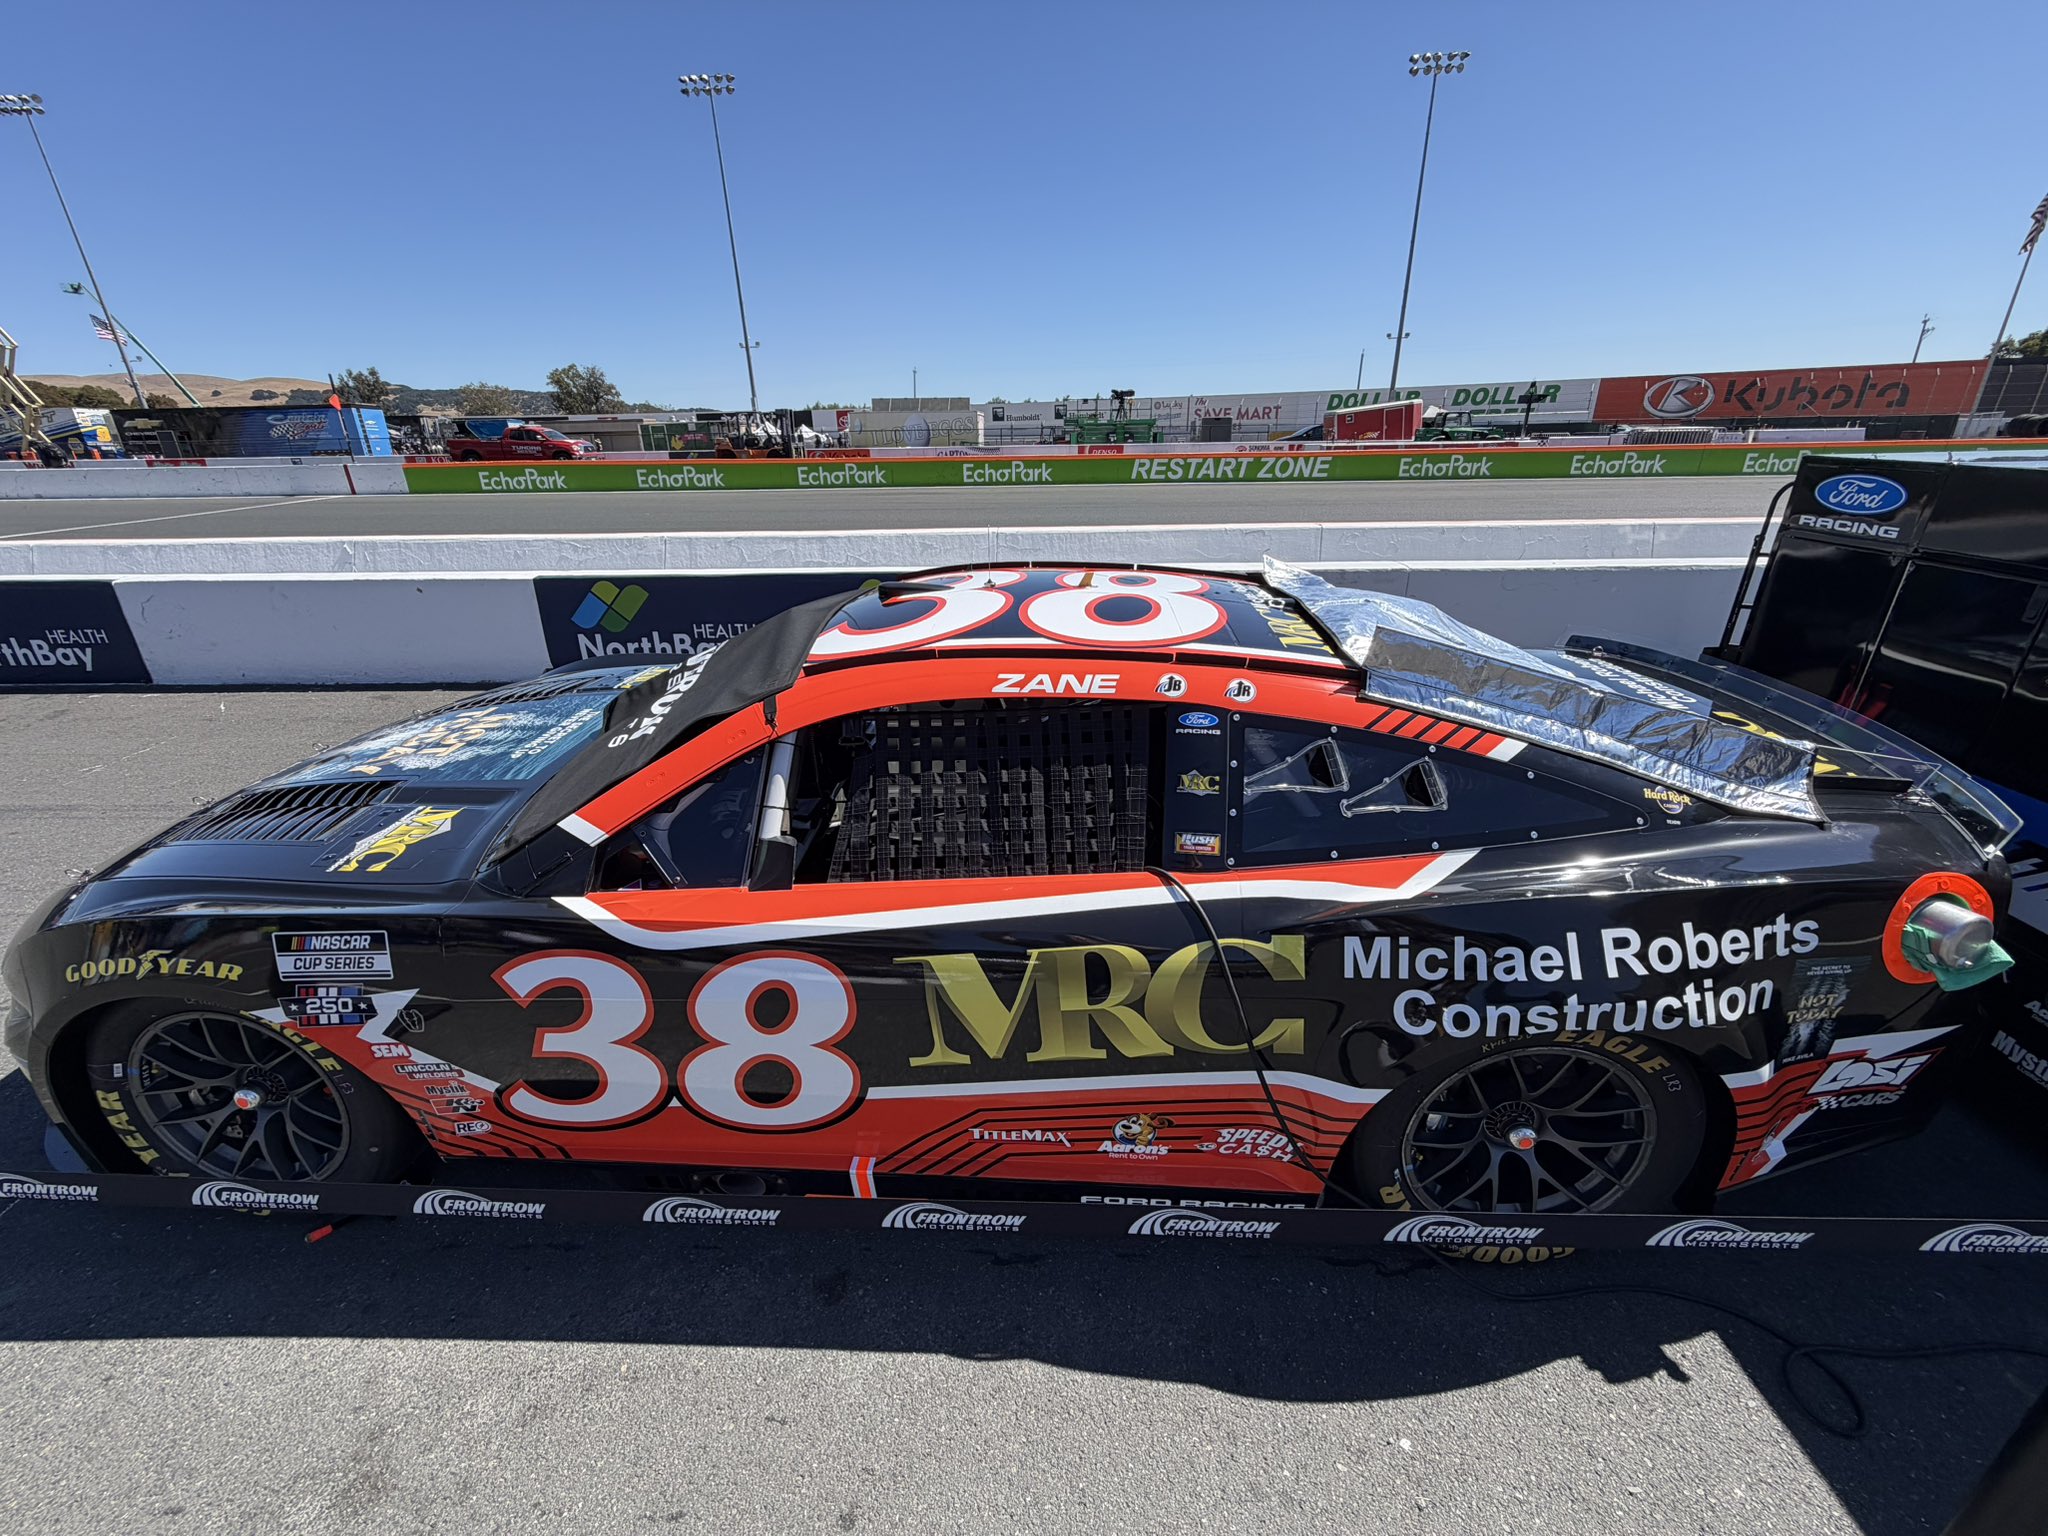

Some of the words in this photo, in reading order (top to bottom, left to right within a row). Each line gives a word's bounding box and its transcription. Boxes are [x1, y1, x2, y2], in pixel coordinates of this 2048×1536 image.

[1723, 373, 1910, 411] Kubota
[1006, 413, 1041, 421] Humboldt
[1194, 407, 1232, 419] SAVE
[1236, 406, 1282, 420] MART
[882, 424, 925, 445] LOVE
[927, 416, 975, 439] EGGS
[1131, 457, 1254, 480] RESTART
[1257, 456, 1333, 479] ZONE
[1398, 454, 1493, 477] EchoPark
[1570, 451, 1667, 475] EchoPark
[1742, 449, 1812, 473] EchoP
[636, 465, 725, 488] EchoPark
[797, 463, 887, 485] EchoPark
[963, 460, 1053, 482] EchoPark
[478, 468, 568, 490] EchoPark
[1829, 479, 1888, 509] Ford
[1798, 515, 1900, 539] RACING
[804, 568, 1228, 661] 38
[45, 629, 109, 644] HEALTH
[577, 631, 726, 660] NorthBa
[992, 673, 1120, 694] ZANE
[1185, 714, 1211, 725] Ford
[1176, 773, 1221, 791] MRC
[1643, 788, 1667, 801] Hard
[1668, 791, 1692, 805] Rock
[1182, 834, 1218, 845] RUSH
[310, 935, 371, 950] NASCAR
[1343, 930, 1584, 981] Michael
[1601, 912, 1820, 979] Roberts
[293, 957, 324, 971] CUP
[325, 956, 375, 970] SERIES
[306, 998, 353, 1014] 250
[892, 934, 1306, 1067] MRC
[1393, 978, 1774, 1037] Construction
[1798, 993, 1838, 1008] NOT
[1786, 1006, 1845, 1024] TODAY
[490, 948, 865, 1134] 38
[371, 1044, 409, 1057] SEM
[1552, 1029, 1671, 1074] EAGLE
[397, 1064, 451, 1074] LINCOLN
[413, 1071, 459, 1079] WELDERS
[424, 1083, 468, 1096] Mystik
[1841, 1090, 1905, 1108] CARS
[1097, 1140, 1170, 1155] Aaron's
[1108, 1152, 1128, 1160] Rent
[3, 1182, 98, 1196] FRONTROW
[6, 1192, 99, 1201] MOTORSPORTS
[220, 1190, 319, 1205] FRONTROW
[224, 1200, 319, 1210] MOTORSPORTS
[1081, 1195, 1172, 1207] FORD
[443, 1199, 546, 1214] FRONTROW
[674, 1206, 781, 1221] FRONTROW
[445, 1209, 542, 1220] MOTORSPORTS
[677, 1217, 776, 1226] MOTORSPORTS
[915, 1211, 1027, 1226] FRONTROW
[917, 1223, 1019, 1232] MOTORSPORTS
[1163, 1218, 1281, 1233] FRONTROW
[1422, 1225, 1544, 1240] FRONTROW
[1166, 1229, 1271, 1239] MOTORSPORTS
[1422, 1236, 1532, 1245] MOTORSPORTS
[1685, 1229, 1814, 1244] FRONTROW
[1685, 1240, 1799, 1249] MOTORSPORTS
